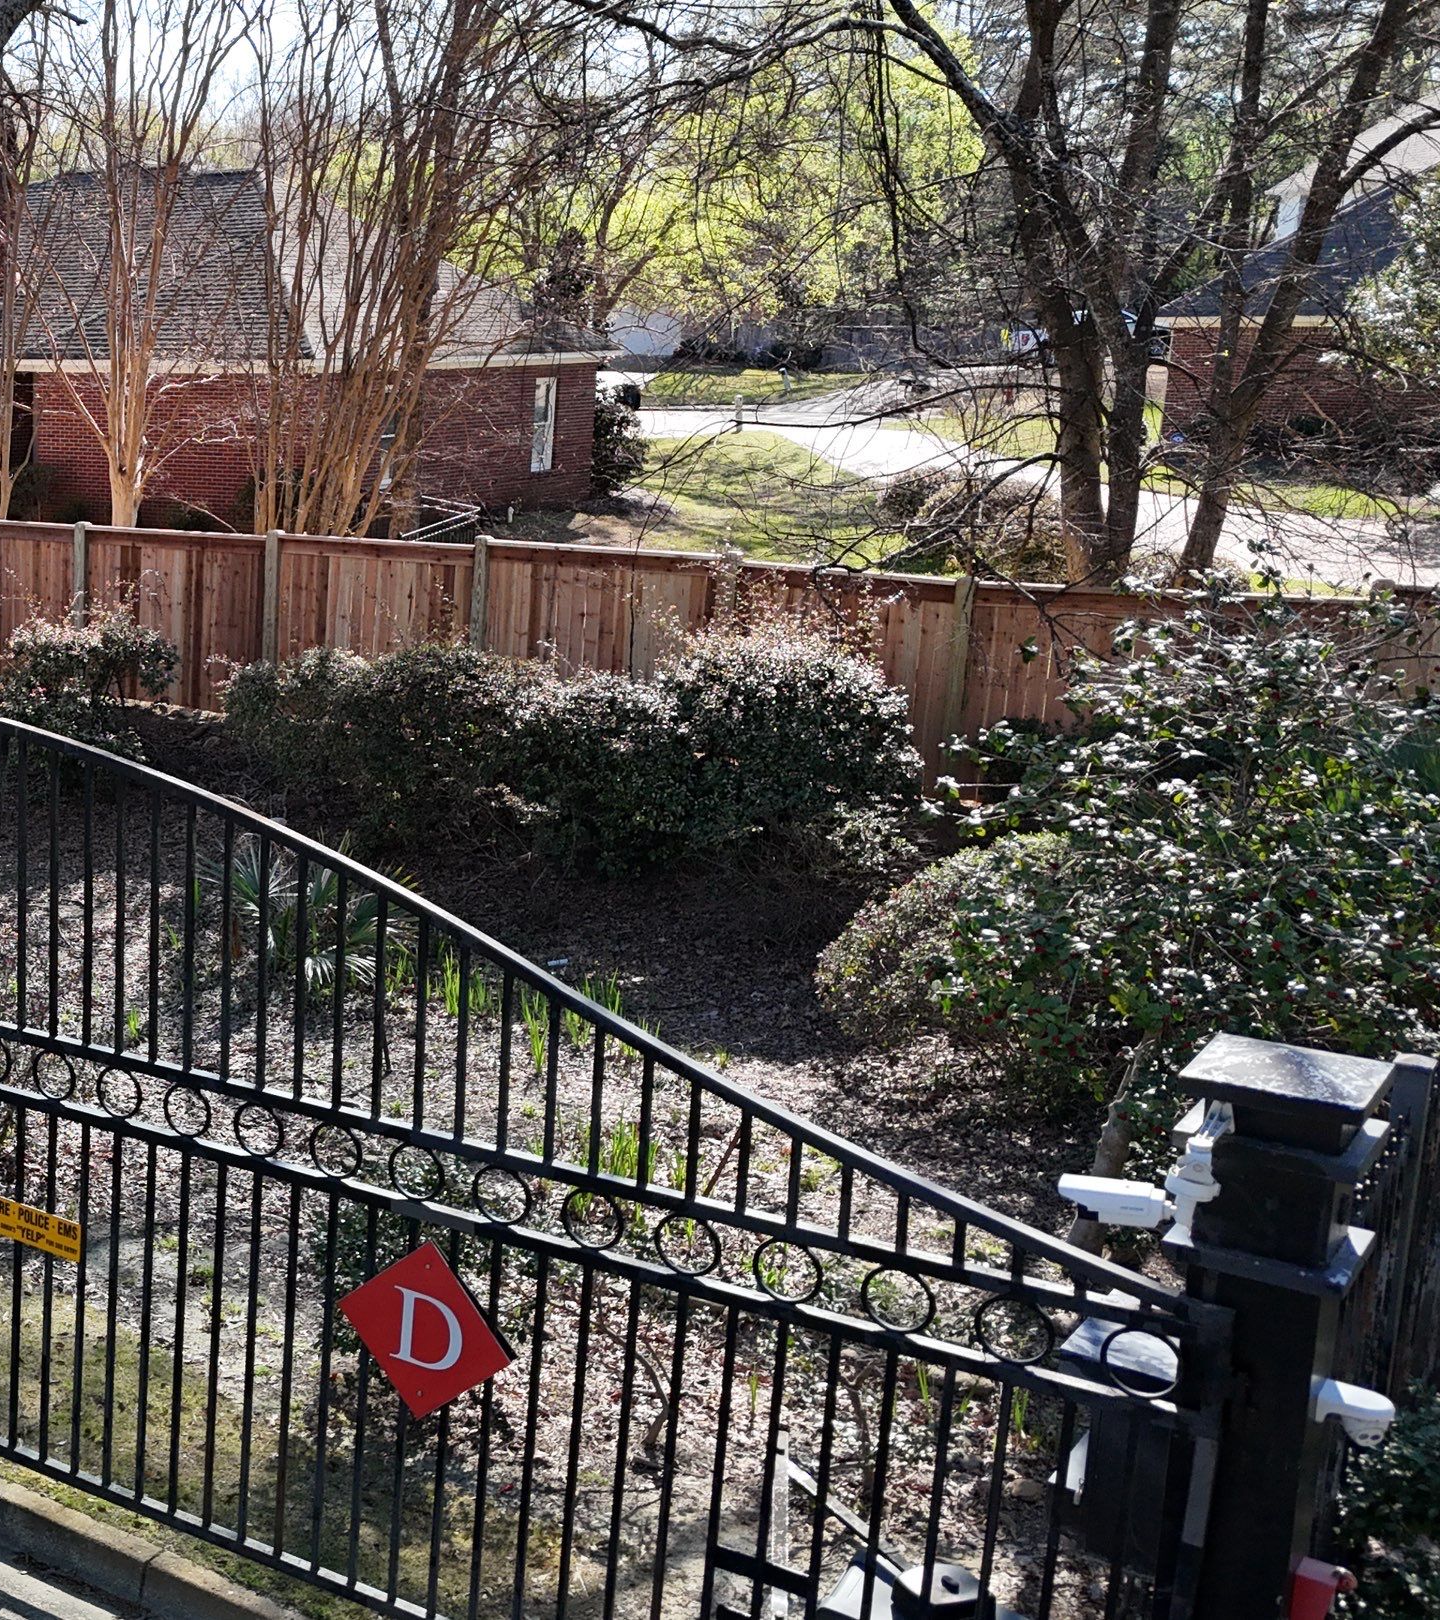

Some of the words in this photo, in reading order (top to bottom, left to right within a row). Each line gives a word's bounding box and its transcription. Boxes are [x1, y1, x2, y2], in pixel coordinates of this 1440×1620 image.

[18, 1206, 49, 1231] POLICE
[57, 1221, 78, 1240] EMS
[389, 1285, 463, 1371] D
